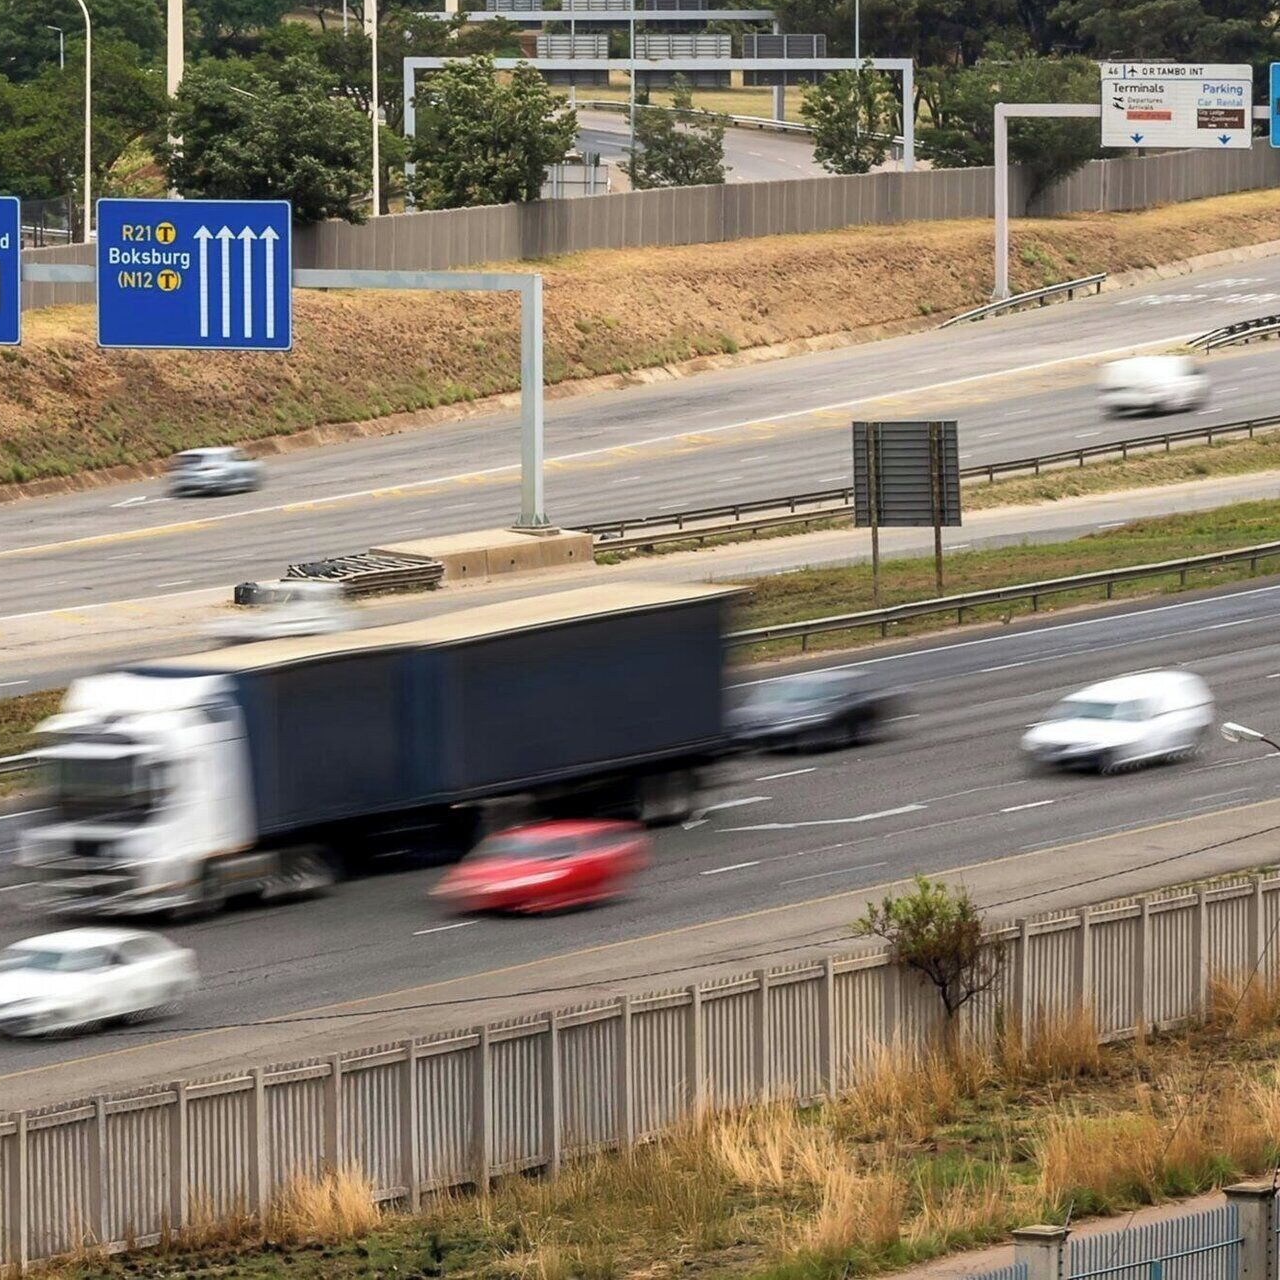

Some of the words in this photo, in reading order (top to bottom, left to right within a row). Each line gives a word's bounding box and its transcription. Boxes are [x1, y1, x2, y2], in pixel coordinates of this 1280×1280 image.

[1157, 67, 1186, 75] TAMBO
[1189, 67, 1204, 75] INT
[1112, 83, 1164, 93] Terminals
[1202, 84, 1243, 96] Parking
[1197, 99, 1212, 107] Car
[1216, 99, 1243, 107] Rental
[122, 224, 152, 242] R21
[108, 247, 191, 269] Boksburg
